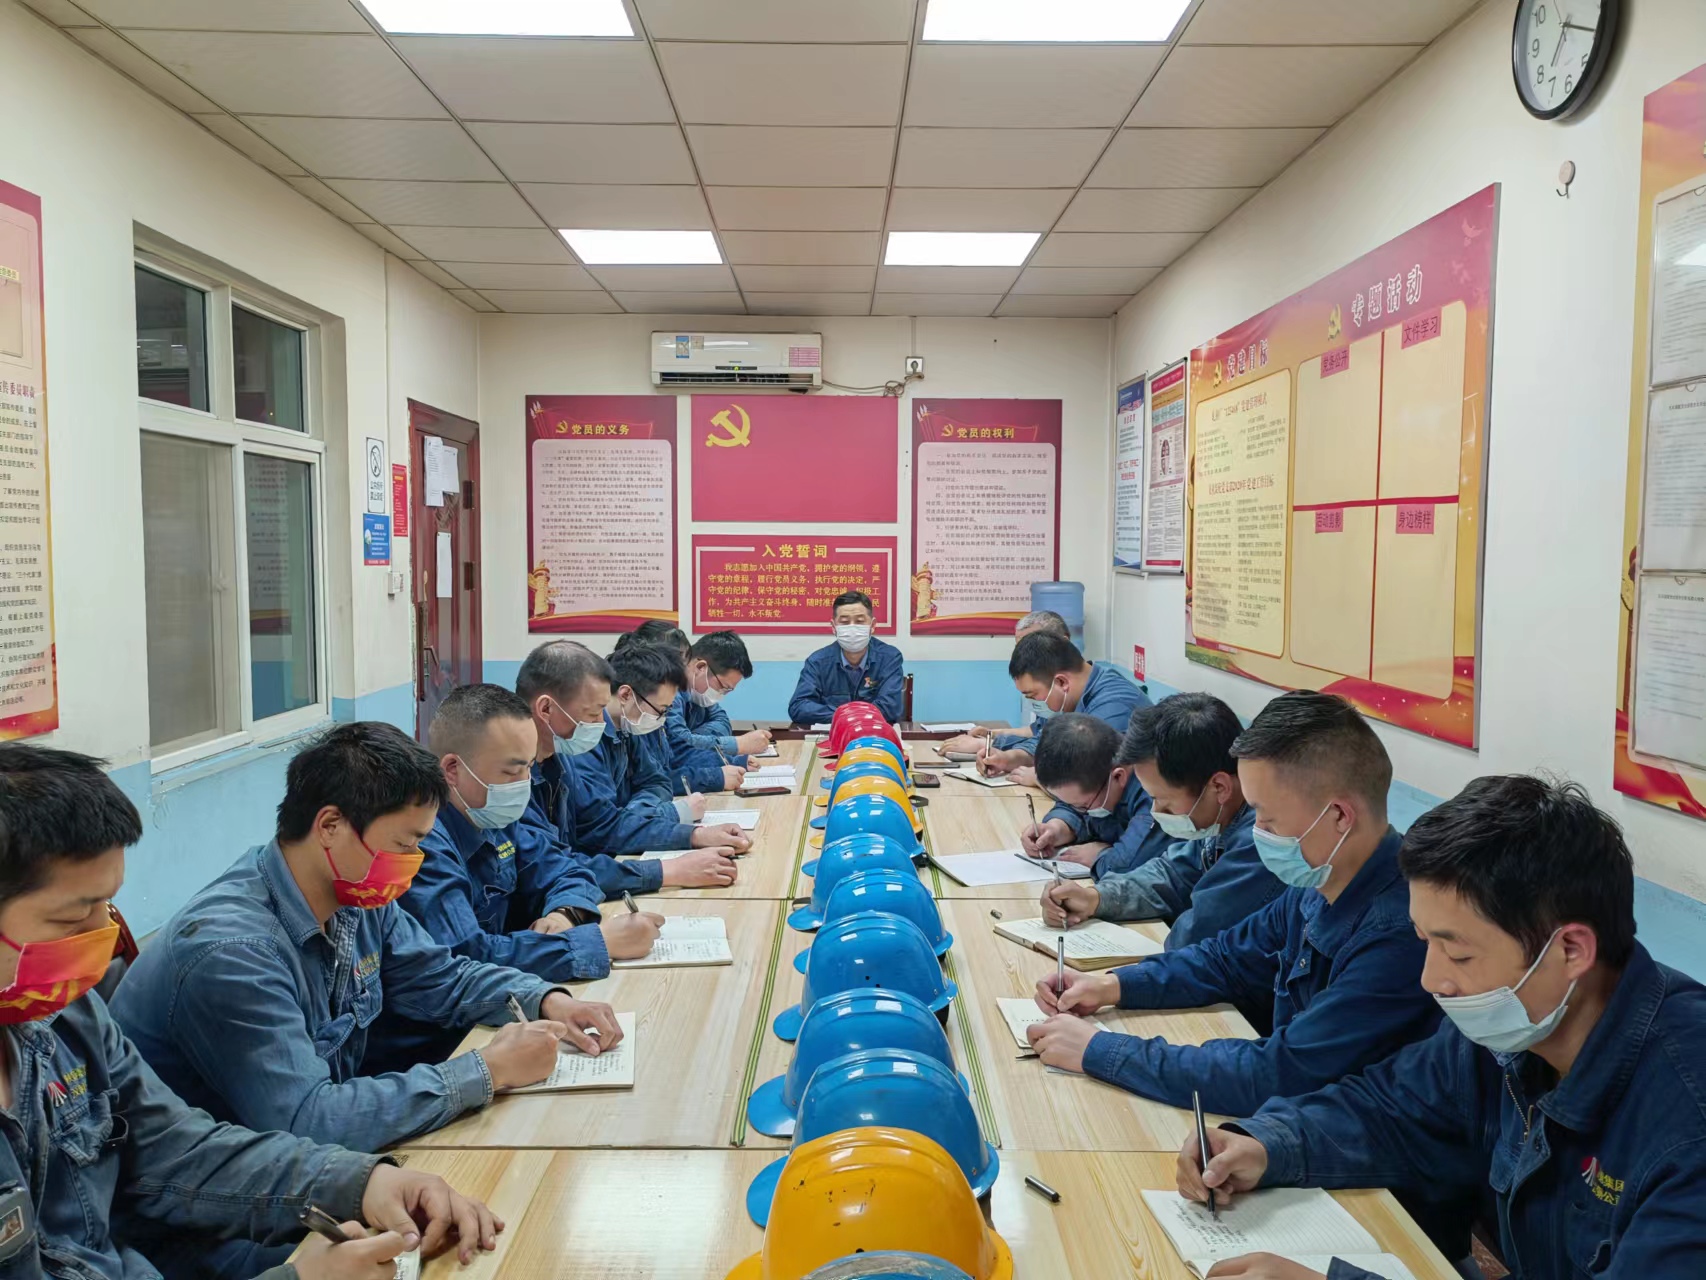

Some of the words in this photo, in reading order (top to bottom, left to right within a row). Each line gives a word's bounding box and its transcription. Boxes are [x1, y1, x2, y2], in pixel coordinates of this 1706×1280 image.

[1532, 5, 1546, 27] 10
[1532, 38, 1540, 58] 9
[1536, 65, 1544, 84] 8
[1564, 74, 1572, 94] 6
[1548, 76, 1556, 97] 7
[1351, 264, 1422, 328] 专题活动
[1403, 315, 1438, 343] 文件学习
[571, 423, 630, 436] 党员的义务
[956, 427, 1015, 439] 党员的权利
[1398, 510, 1431, 529] 身边榜样
[762, 544, 828, 558] 入党誓词
